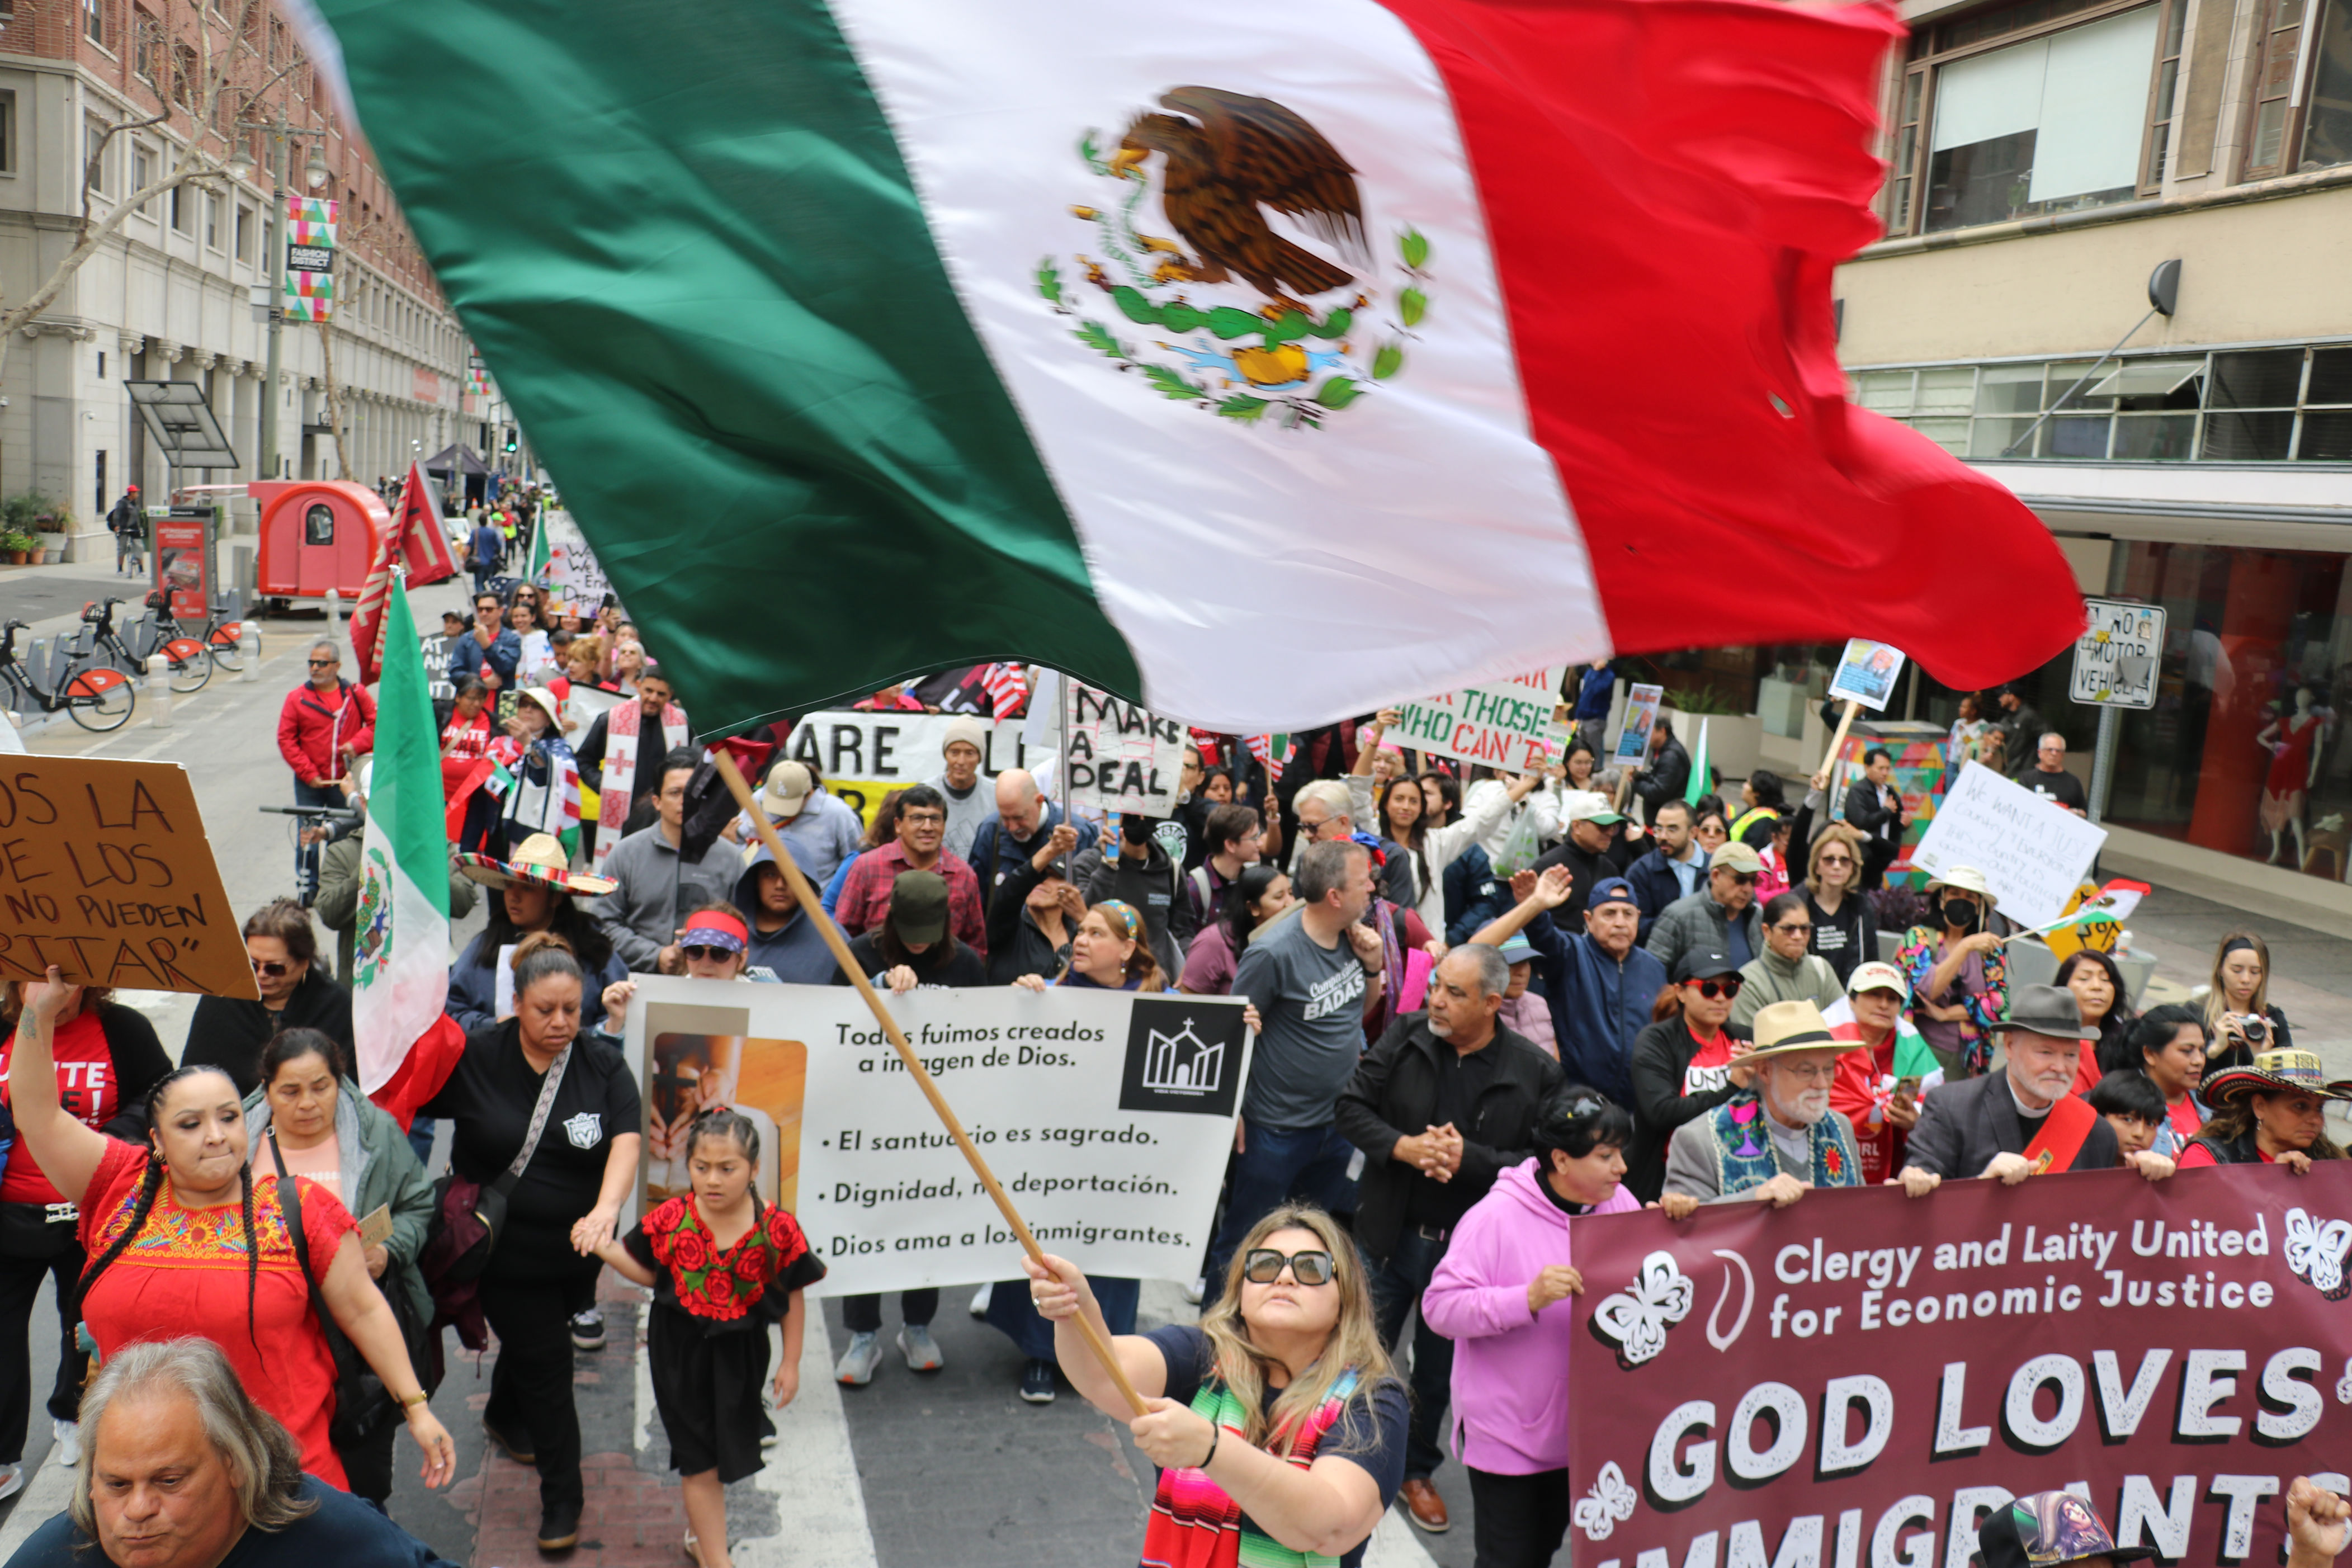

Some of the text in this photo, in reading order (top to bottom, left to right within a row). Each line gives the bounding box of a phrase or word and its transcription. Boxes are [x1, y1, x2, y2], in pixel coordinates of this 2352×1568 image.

[291, 247, 330, 258] FASHION
[291, 257, 329, 267] DISTRICT
[1076, 687, 1180, 744] MAKE
[1462, 689, 1551, 738] THOSE
[794, 723, 899, 776] ARE
[1069, 731, 1092, 760] A
[1391, 704, 1543, 769] WHO CAN'T
[1070, 761, 1167, 796] DEAL
[86, 779, 174, 833] LA
[64, 841, 173, 887] LOS
[6, 887, 207, 929] NO PUEDEN
[922, 1023, 999, 1045] fuimos
[1007, 1021, 1104, 1042] creados
[859, 1059, 873, 1072] a
[981, 1046, 1010, 1067] de
[1018, 1046, 1076, 1067] Dios.
[839, 1130, 861, 1151] El
[1005, 1127, 1032, 1142] es
[1040, 1124, 1159, 1146] sagrado.
[834, 1177, 962, 1208] Dignidad,
[1012, 1172, 1179, 1196] deportación.
[831, 1221, 1191, 1257] Dios ama a los inmigrantes.
[1774, 1212, 2269, 1290] Clergy and Laity United
[1769, 1269, 2274, 1338] for Economic Justice
[1647, 1347, 2325, 1504] GOD LOVES
